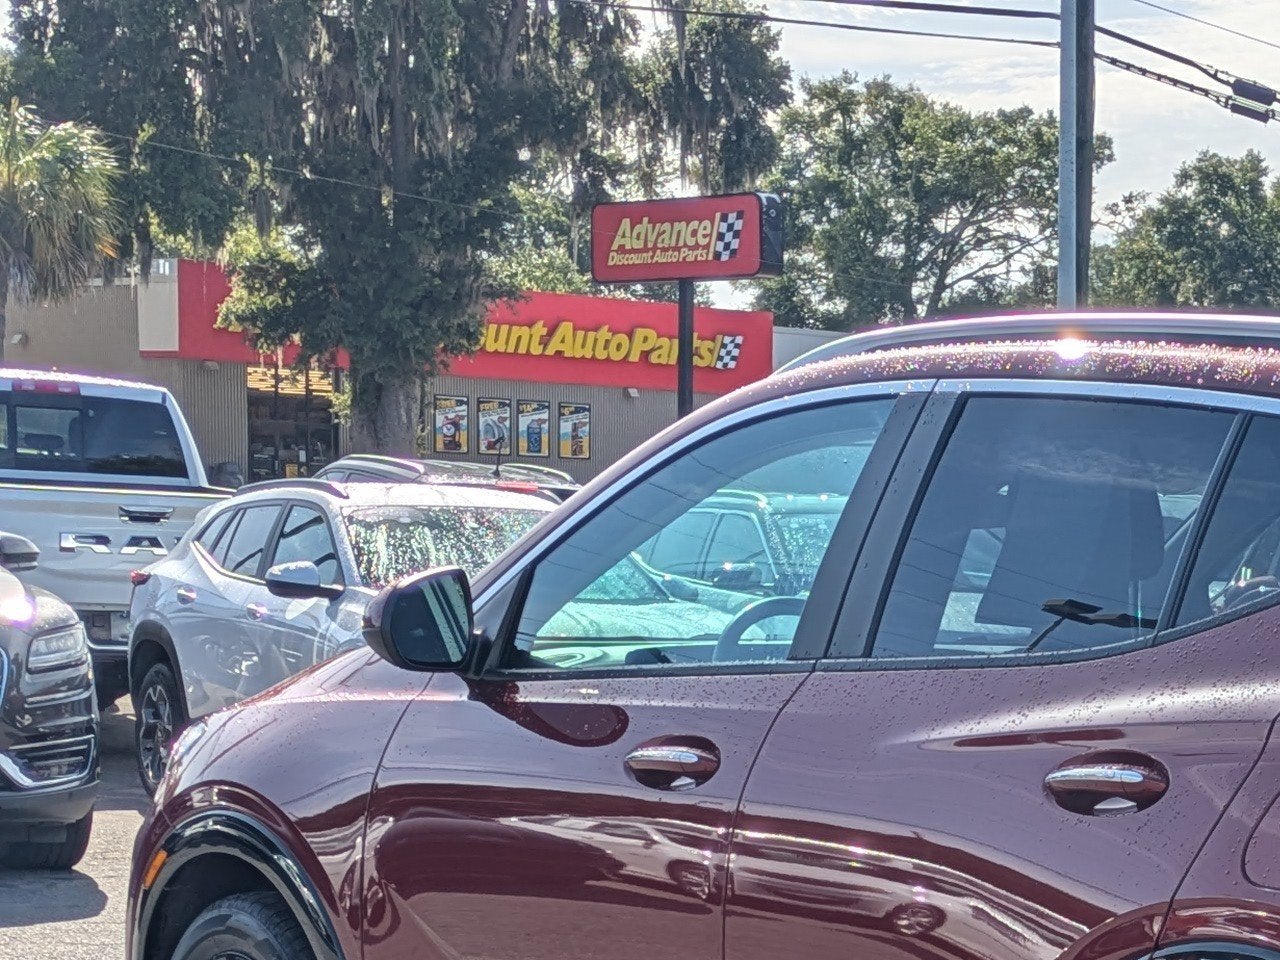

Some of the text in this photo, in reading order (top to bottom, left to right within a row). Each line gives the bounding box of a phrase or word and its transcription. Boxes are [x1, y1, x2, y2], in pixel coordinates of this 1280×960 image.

[611, 216, 712, 250] Advance
[607, 247, 708, 266] Discount Auto Parts
[545, 321, 630, 361] Auto
[59, 532, 183, 556] RA
